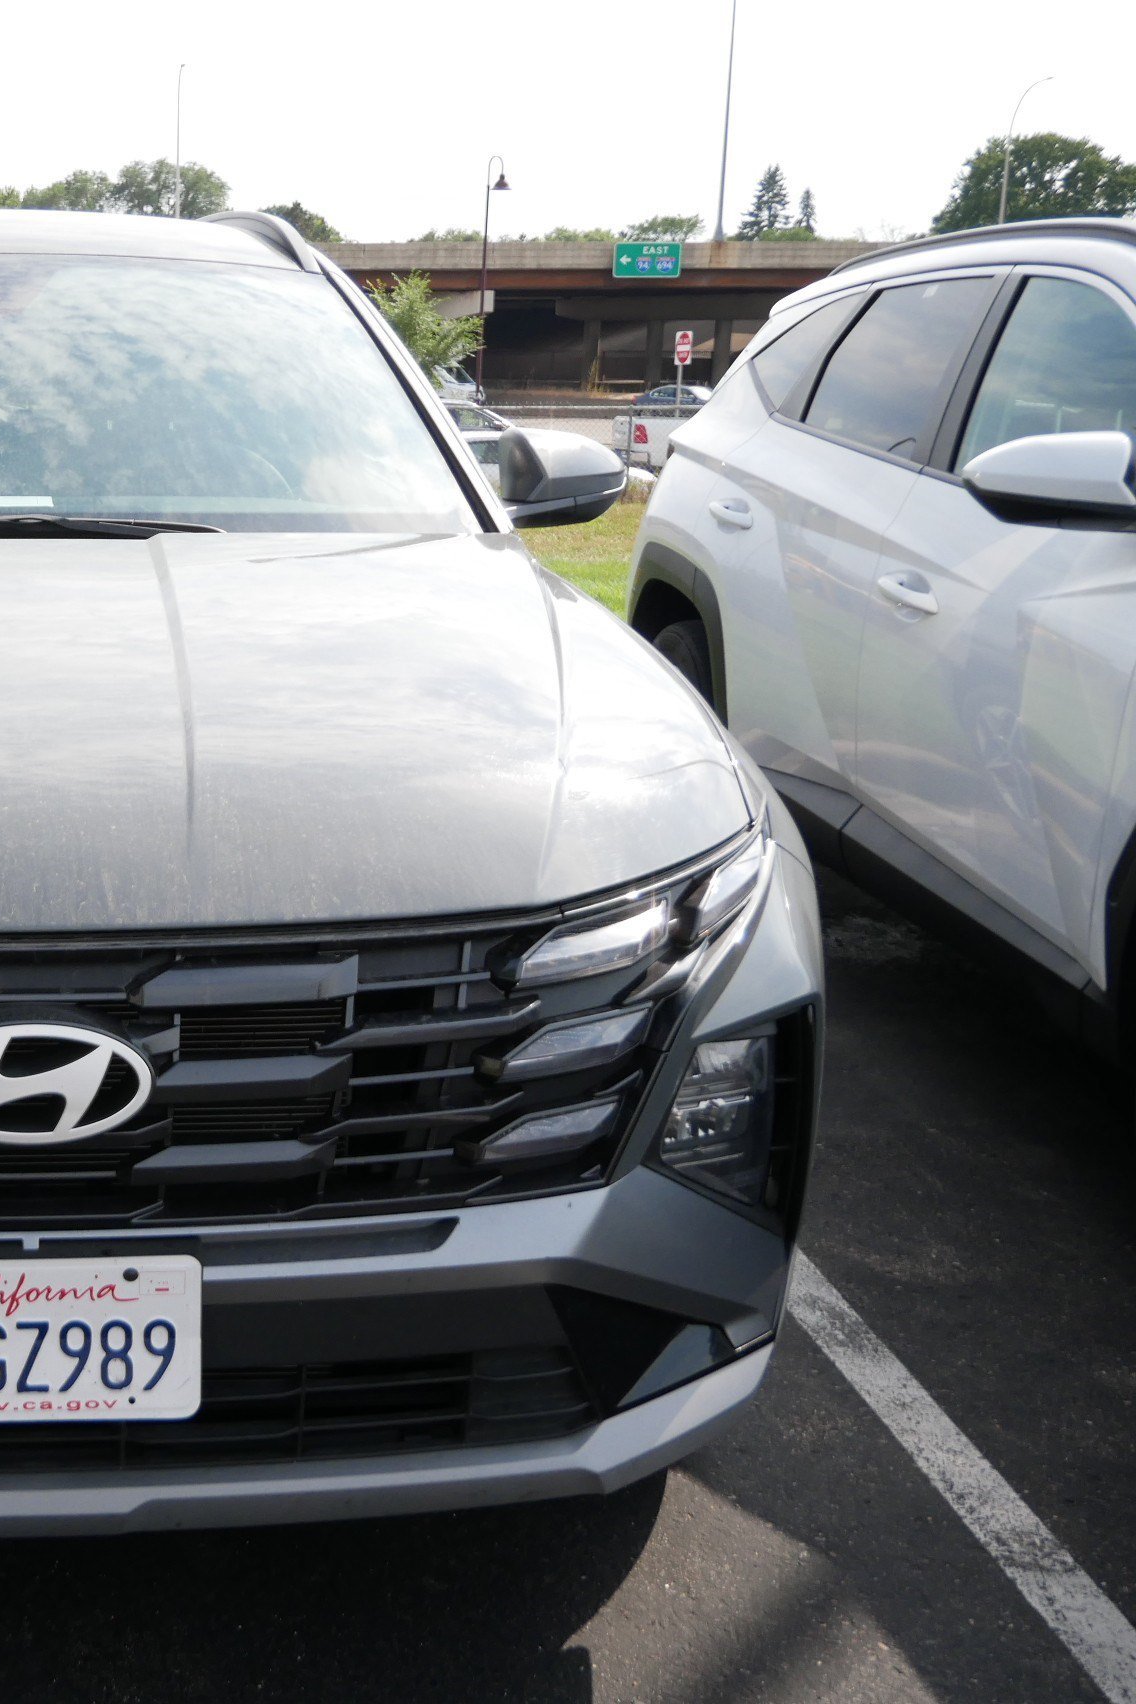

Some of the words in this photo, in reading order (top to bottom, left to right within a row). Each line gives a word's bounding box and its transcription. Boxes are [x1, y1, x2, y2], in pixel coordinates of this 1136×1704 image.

[642, 246, 669, 254] EAST
[638, 261, 649, 269] 94
[657, 261, 673, 269] 694
